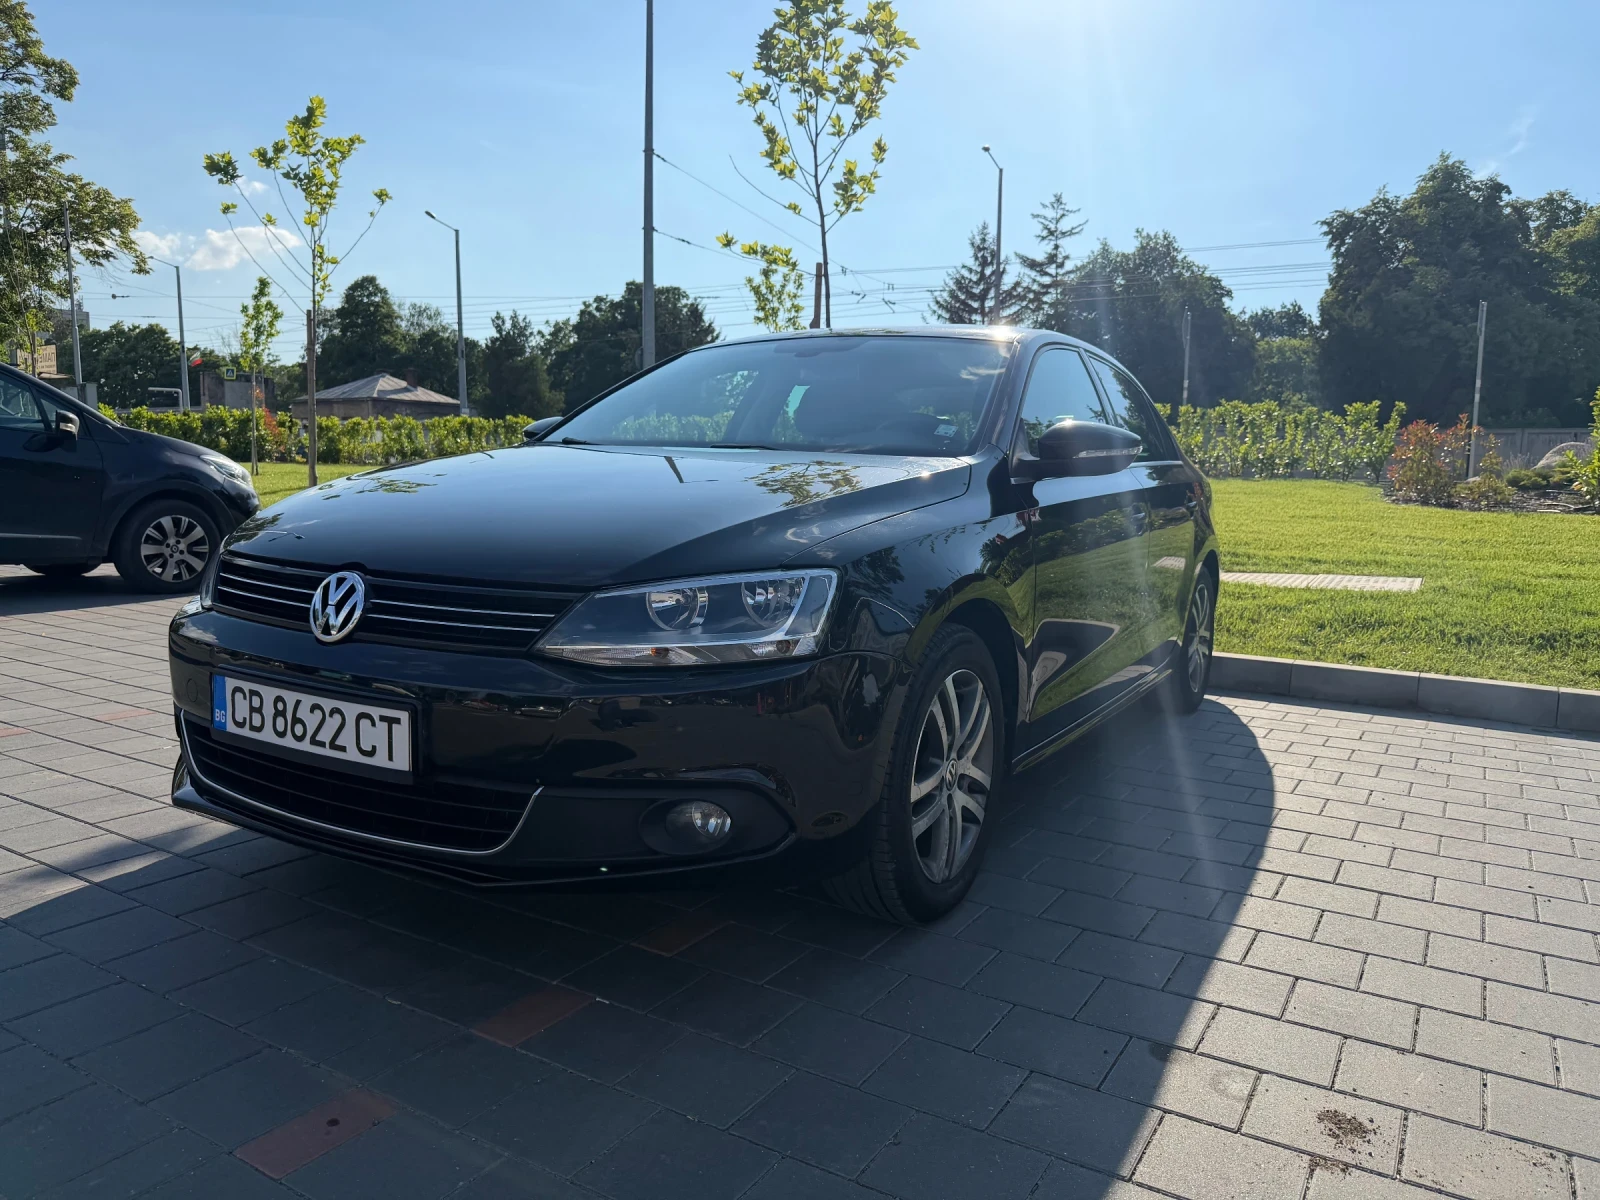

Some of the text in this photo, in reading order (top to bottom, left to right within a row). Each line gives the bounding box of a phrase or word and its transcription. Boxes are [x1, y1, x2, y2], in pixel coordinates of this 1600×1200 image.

[310, 572, 364, 641] VW
[214, 708, 226, 723] BG
[231, 685, 402, 762] CB 8622 CT
